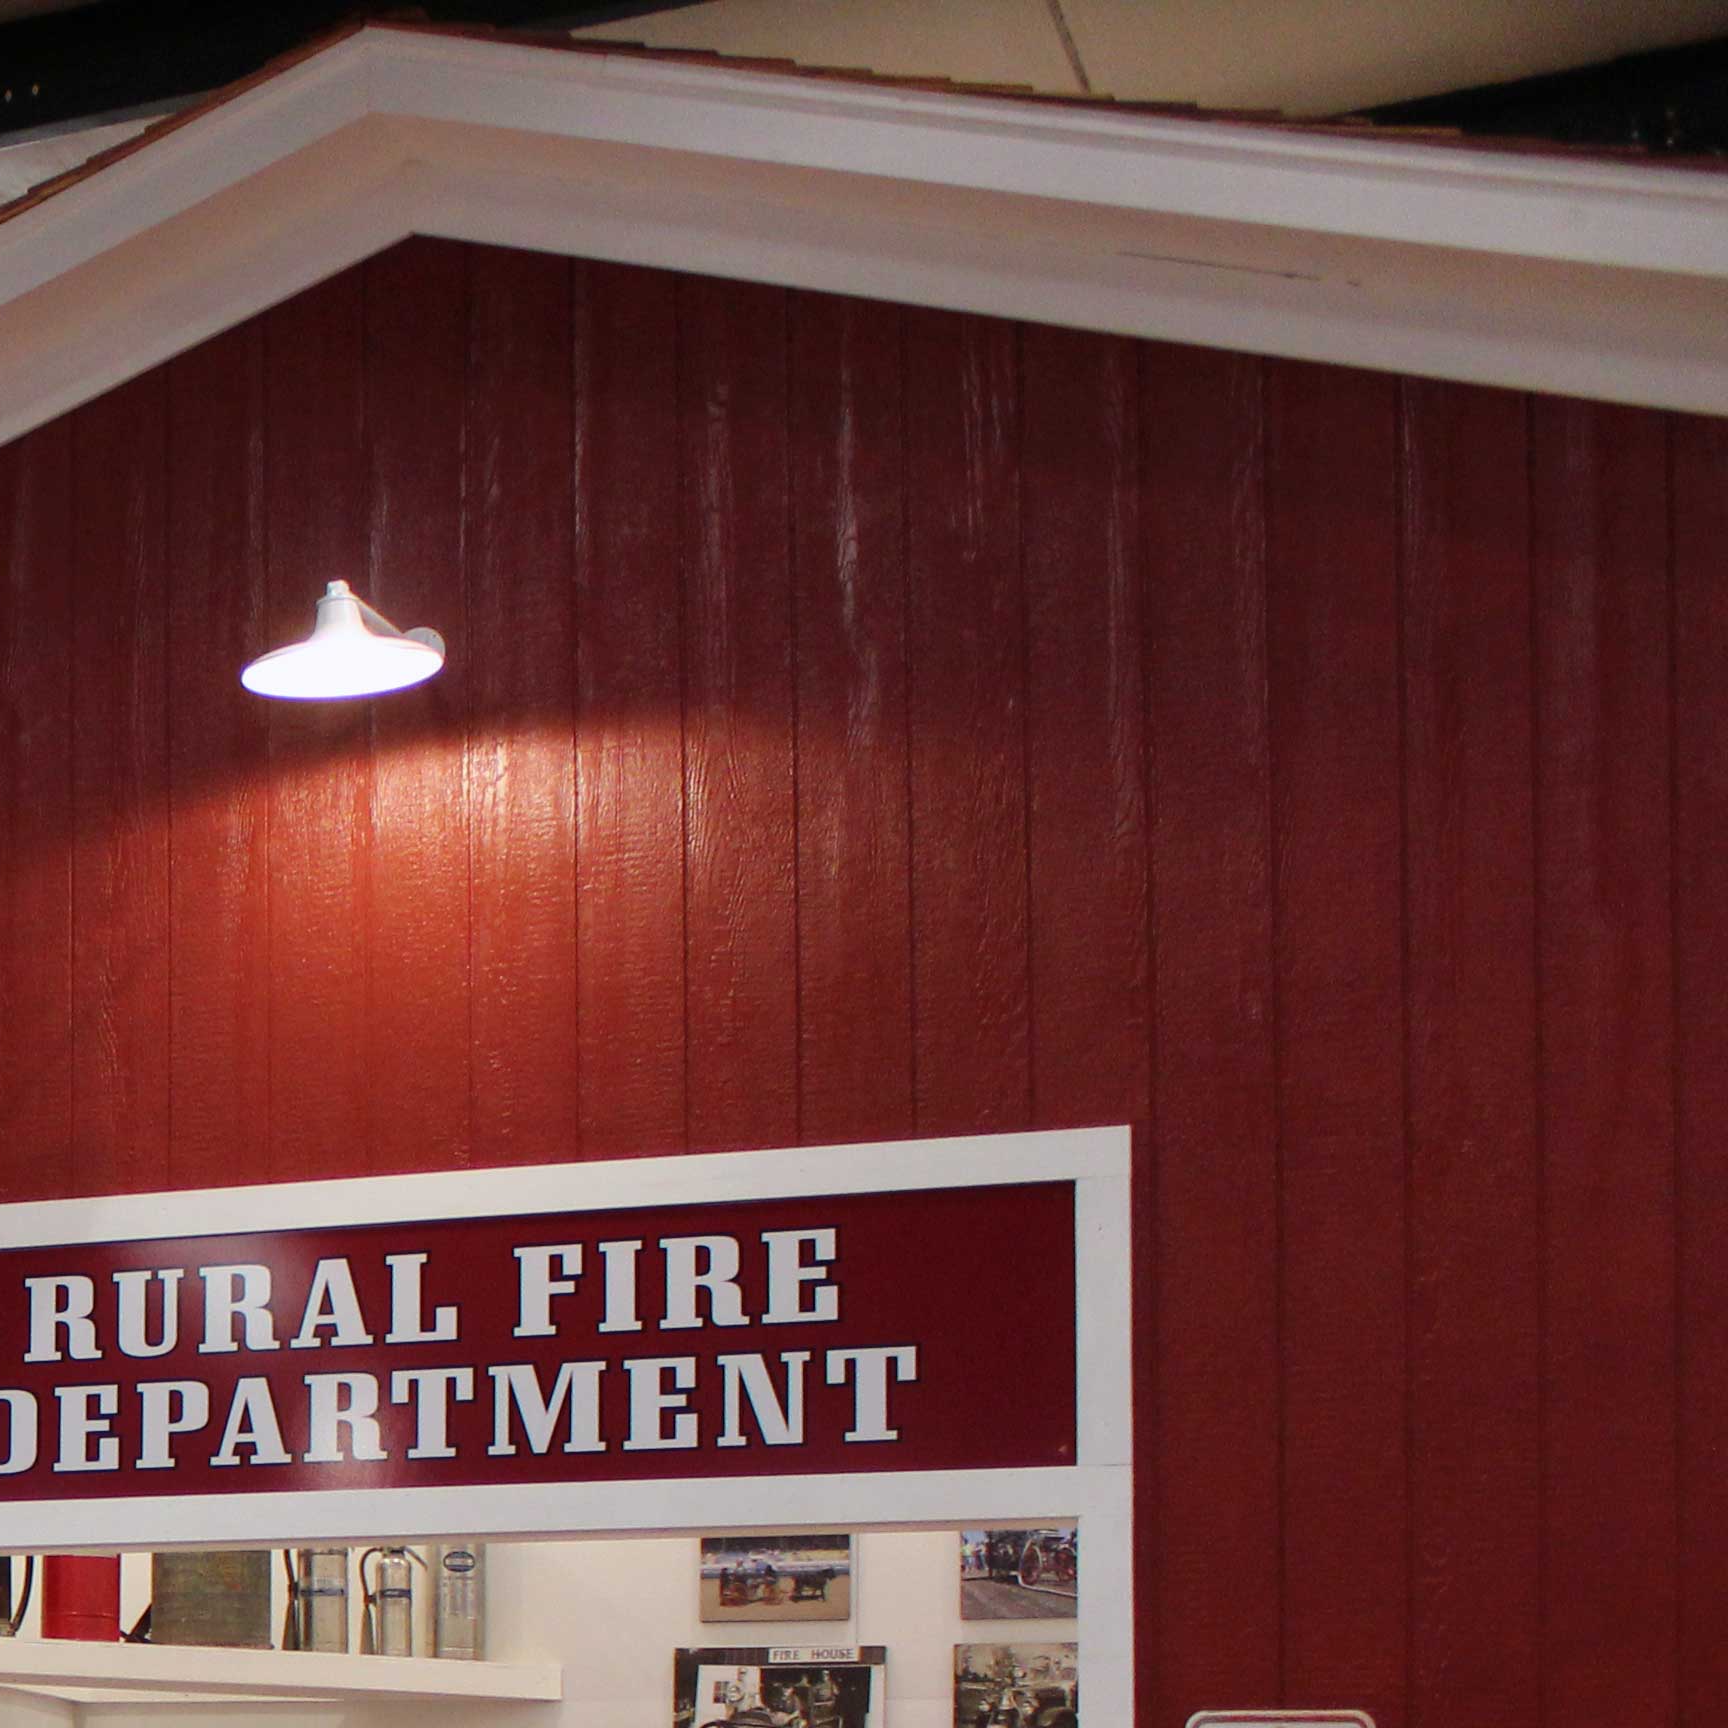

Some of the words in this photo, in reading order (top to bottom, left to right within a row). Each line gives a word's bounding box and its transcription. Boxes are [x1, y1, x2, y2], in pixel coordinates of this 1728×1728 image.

[23, 1252, 458, 1364] RURAL
[513, 1228, 840, 1337] FIRE
[772, 1649, 800, 1661] FIRE
[810, 1648, 854, 1660] HOUSE
